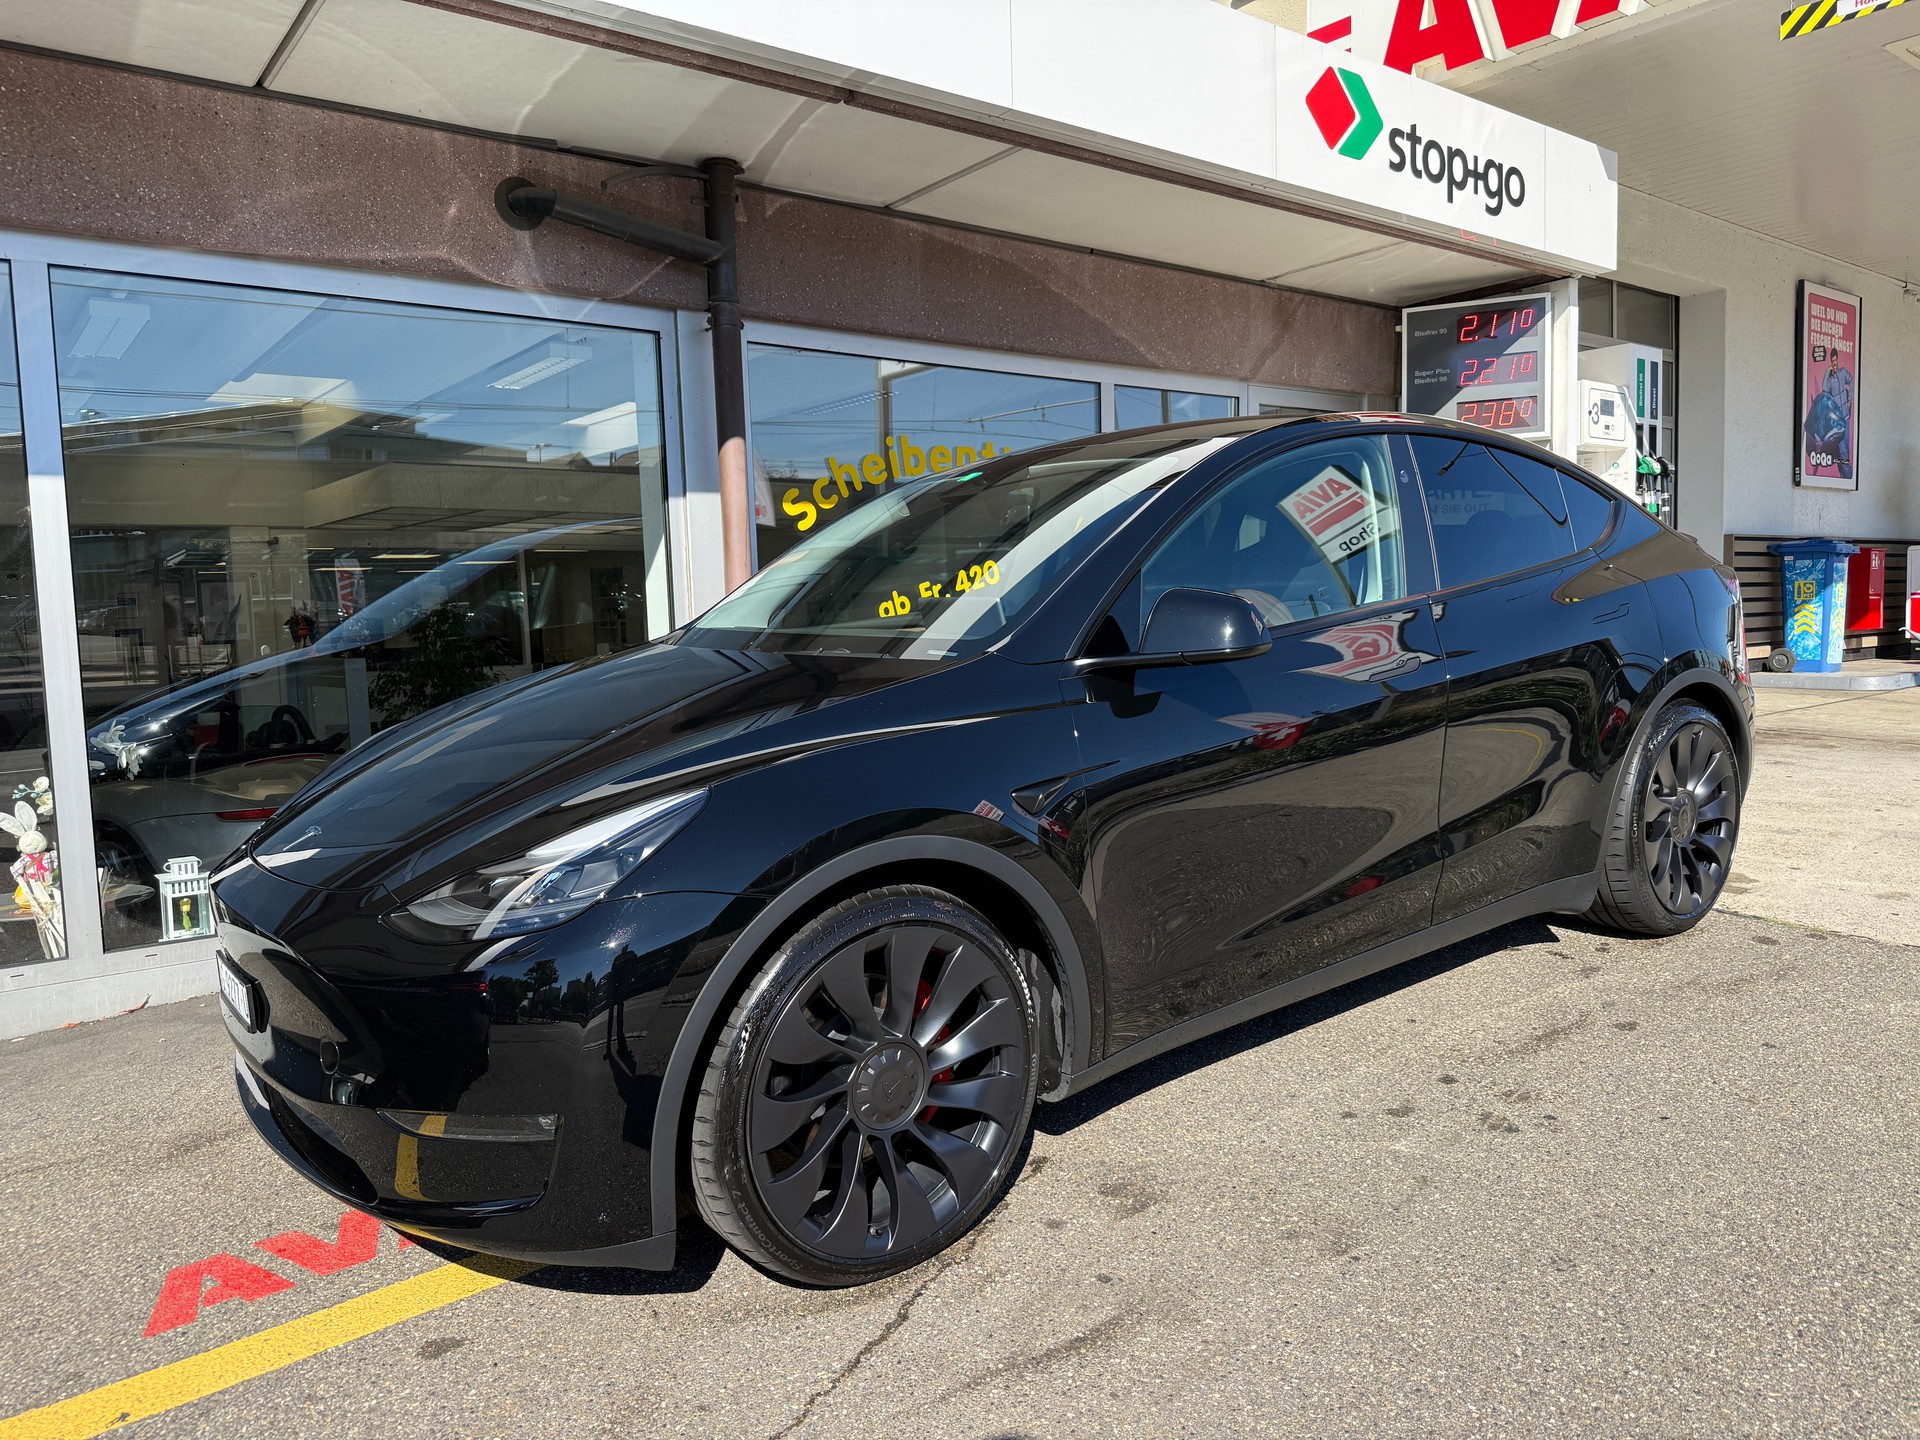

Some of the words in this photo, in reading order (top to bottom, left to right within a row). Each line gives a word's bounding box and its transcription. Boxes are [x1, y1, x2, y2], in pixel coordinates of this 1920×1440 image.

[1389, 124, 1525, 216] stop+go
[1811, 303, 1825, 319] WEIL
[1827, 307, 1834, 321] DU
[1836, 310, 1848, 325] NUR
[1811, 317, 1821, 331] DIE
[1822, 320, 1843, 337] DICKEN
[1811, 332, 1831, 348] FISCHE
[1414, 377, 1438, 385] Bleifrei
[1591, 403, 1600, 425] 3
[1810, 451, 1832, 466] QoQa
[782, 434, 1011, 531] Scheibent
[1441, 504, 1460, 514] SIE
[1464, 503, 1489, 513] GUT
[879, 591, 911, 618] ab
[919, 581, 951, 599] Fr.
[955, 560, 1000, 593] 420
[731, 1190, 741, 1199] 7
[738, 1201, 801, 1270] SportContact
[143, 1208, 415, 1338] AV
